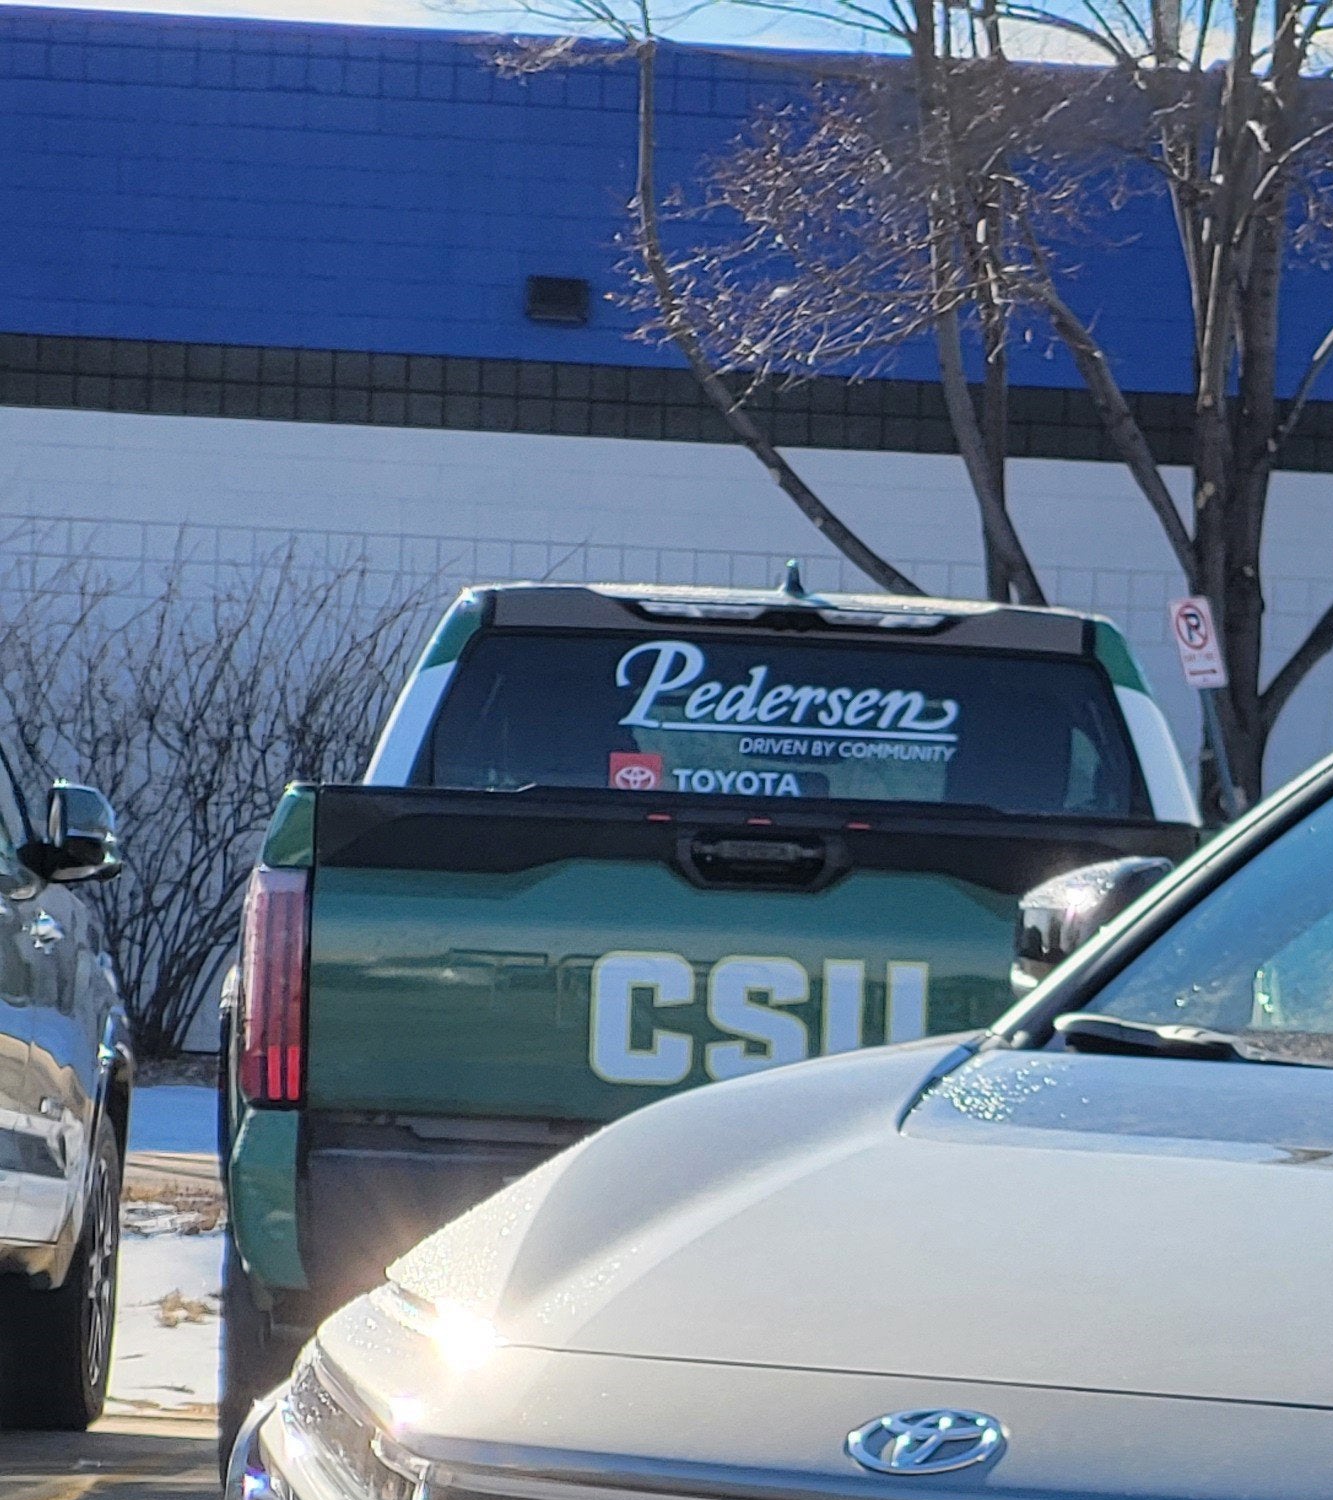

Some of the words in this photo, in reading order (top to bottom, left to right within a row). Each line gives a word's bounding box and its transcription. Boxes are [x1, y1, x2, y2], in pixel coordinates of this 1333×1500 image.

[615, 640, 958, 729] Pedersen
[739, 736, 808, 757] DRIVEN
[811, 740, 835, 758] BY
[838, 741, 957, 763] COMMUNITY
[671, 767, 800, 797] TOYOTA
